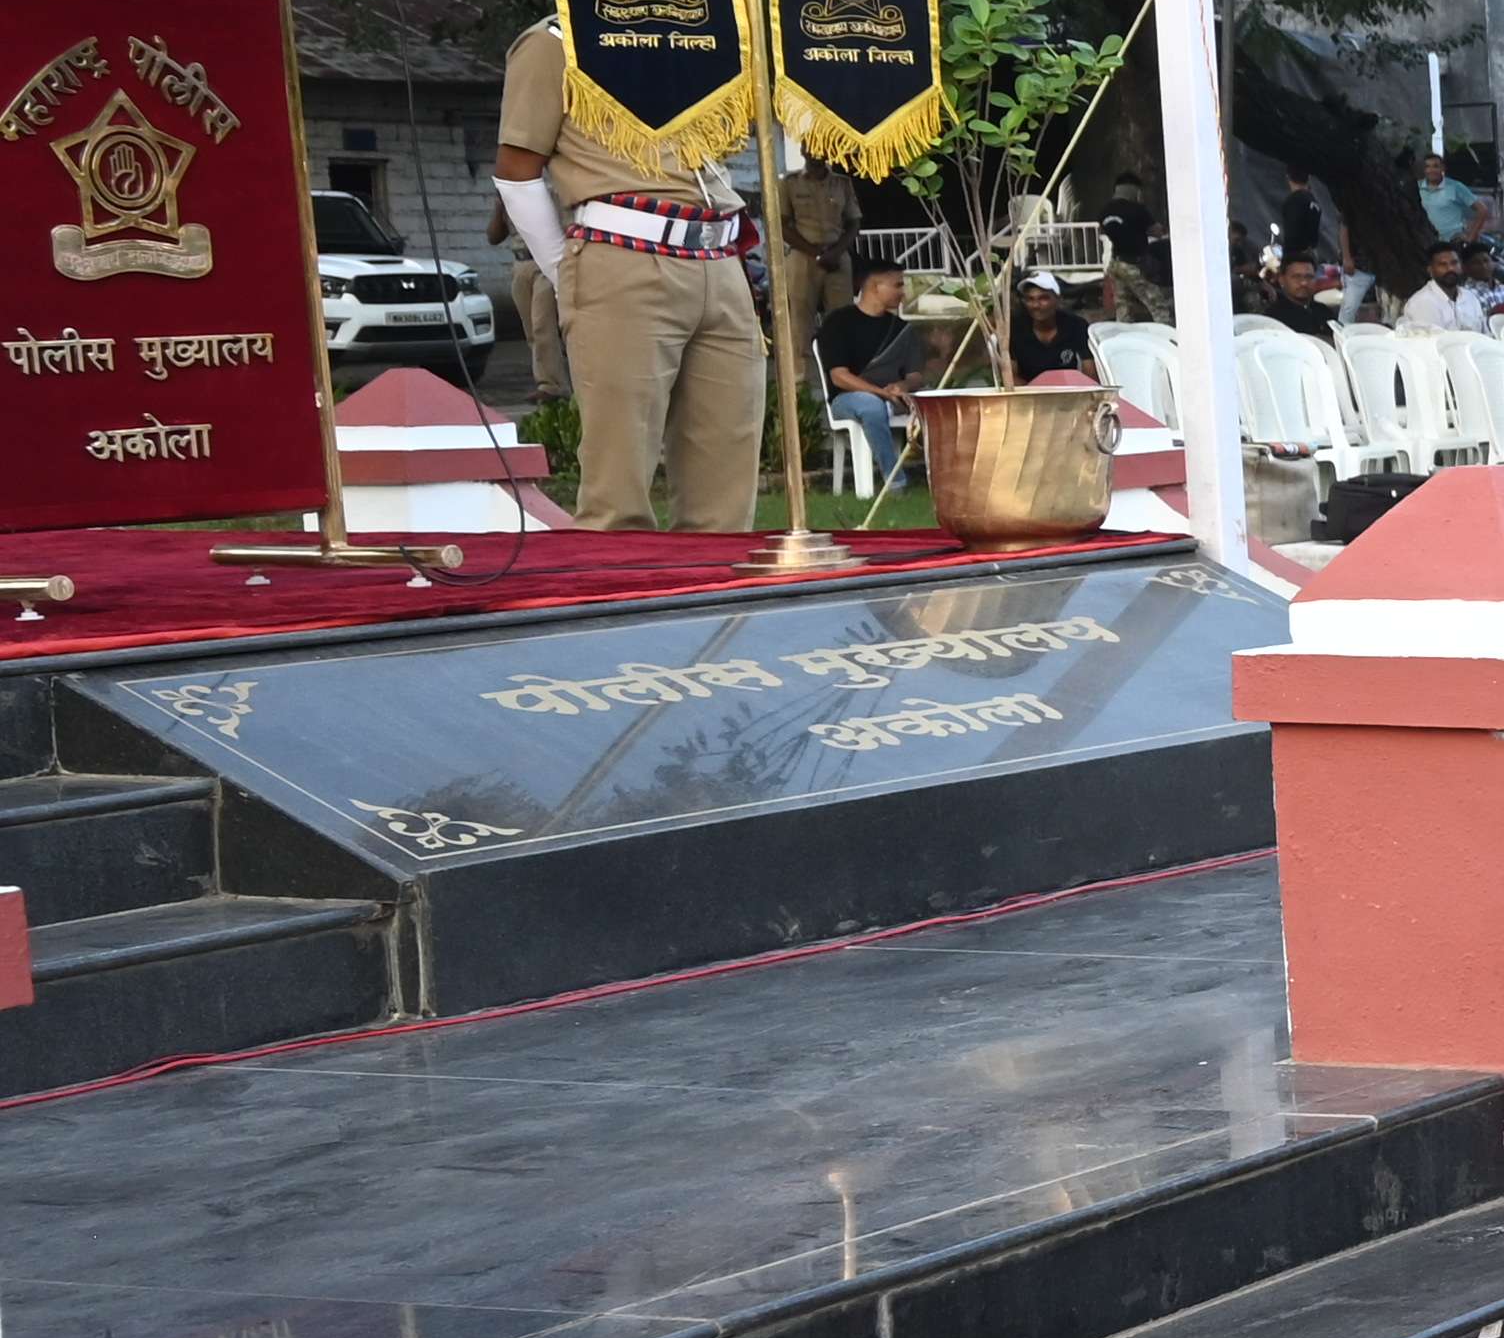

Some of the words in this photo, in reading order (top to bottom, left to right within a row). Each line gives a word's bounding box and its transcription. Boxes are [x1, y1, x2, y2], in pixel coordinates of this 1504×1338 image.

[599, 29, 662, 48] अकोला
[667, 30, 717, 51] जिल्हा
[803, 44, 861, 63] अकोला
[866, 45, 914, 65] जिल्हा
[0, 36, 111, 141] महाराष्ट्र
[128, 34, 241, 145] पोलीस
[2, 327, 116, 375] पोलीस
[133, 333, 275, 381] मुख्यालय
[85, 412, 212, 462] अकोला
[479, 660, 783, 716] पोलीस
[780, 616, 1122, 690] मुख्यालय
[808, 693, 1065, 751] अकोला
